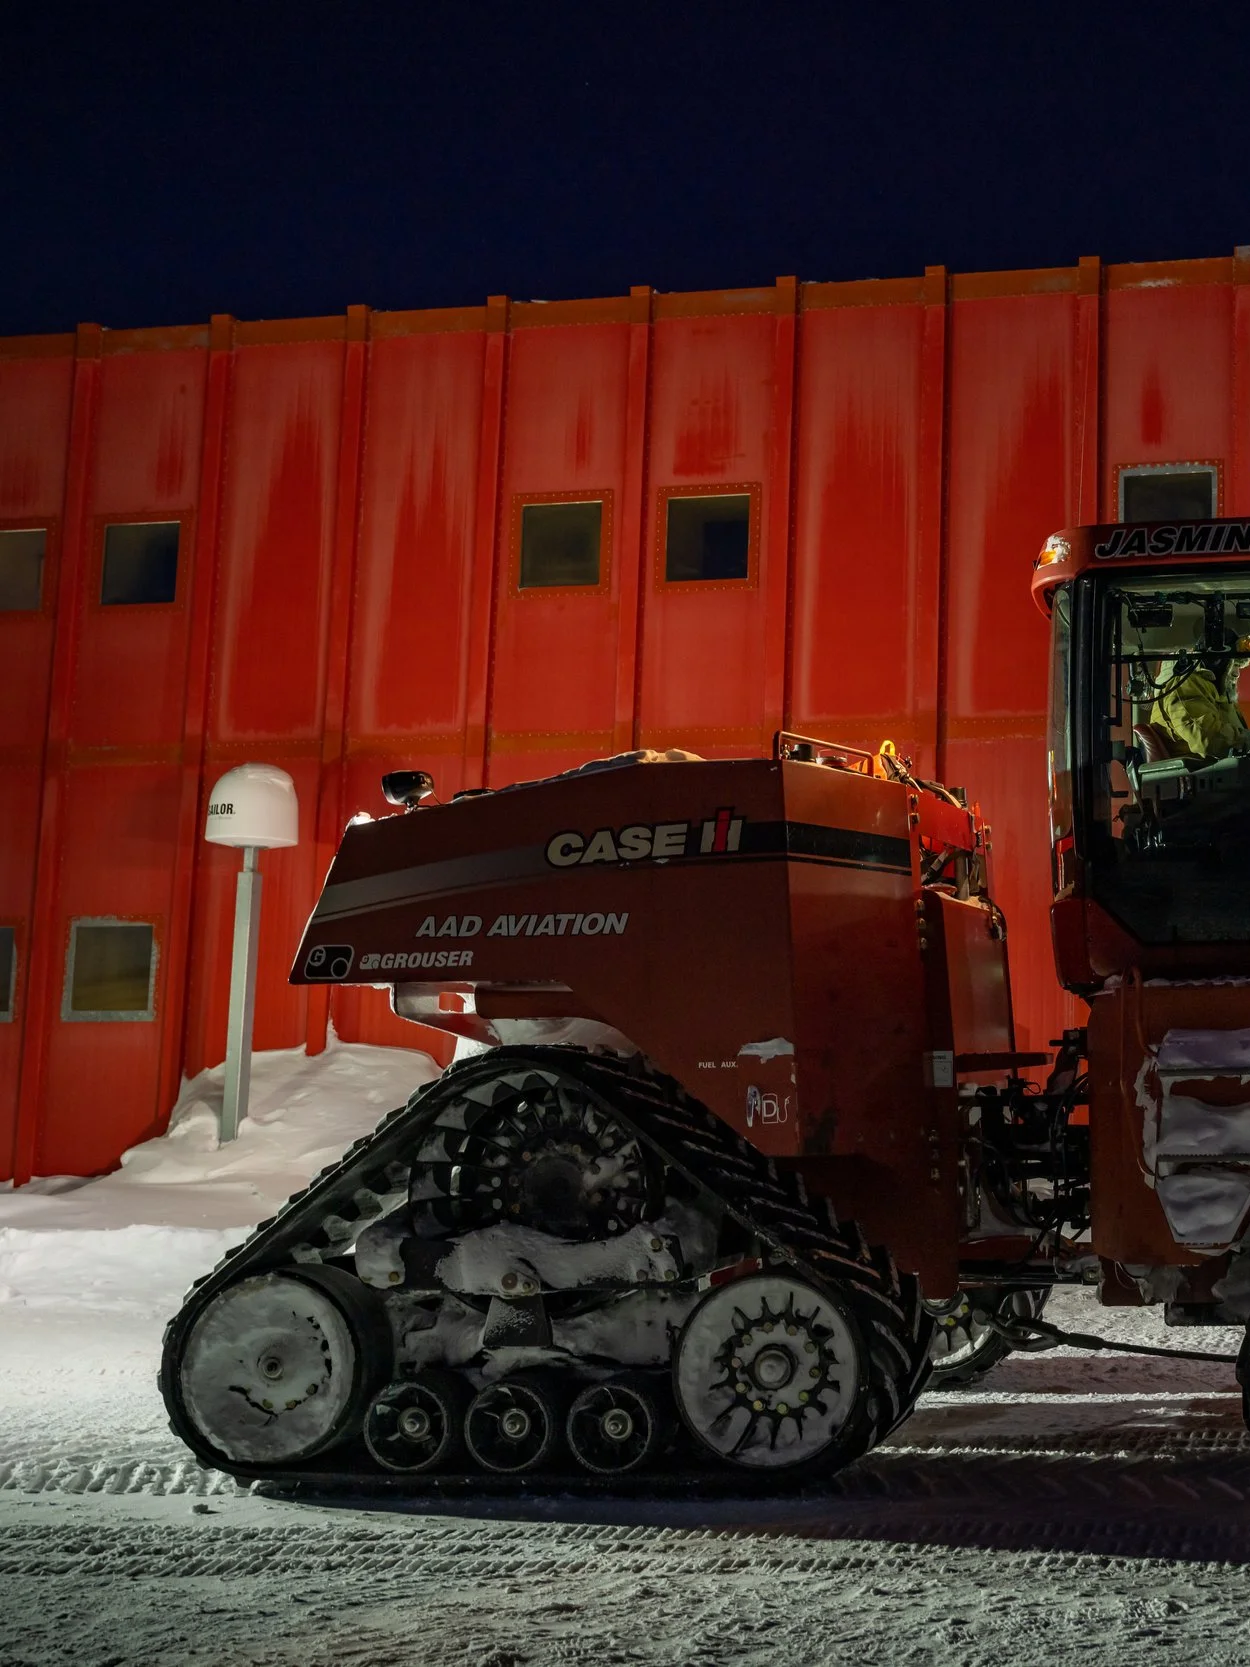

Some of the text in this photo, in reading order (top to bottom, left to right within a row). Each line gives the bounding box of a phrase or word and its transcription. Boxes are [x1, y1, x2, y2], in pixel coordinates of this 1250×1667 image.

[546, 820, 690, 868] CASE
[415, 912, 630, 938] AAD AVIATION
[381, 951, 473, 969] GROUSER
[698, 1061, 716, 1069] FUEL
